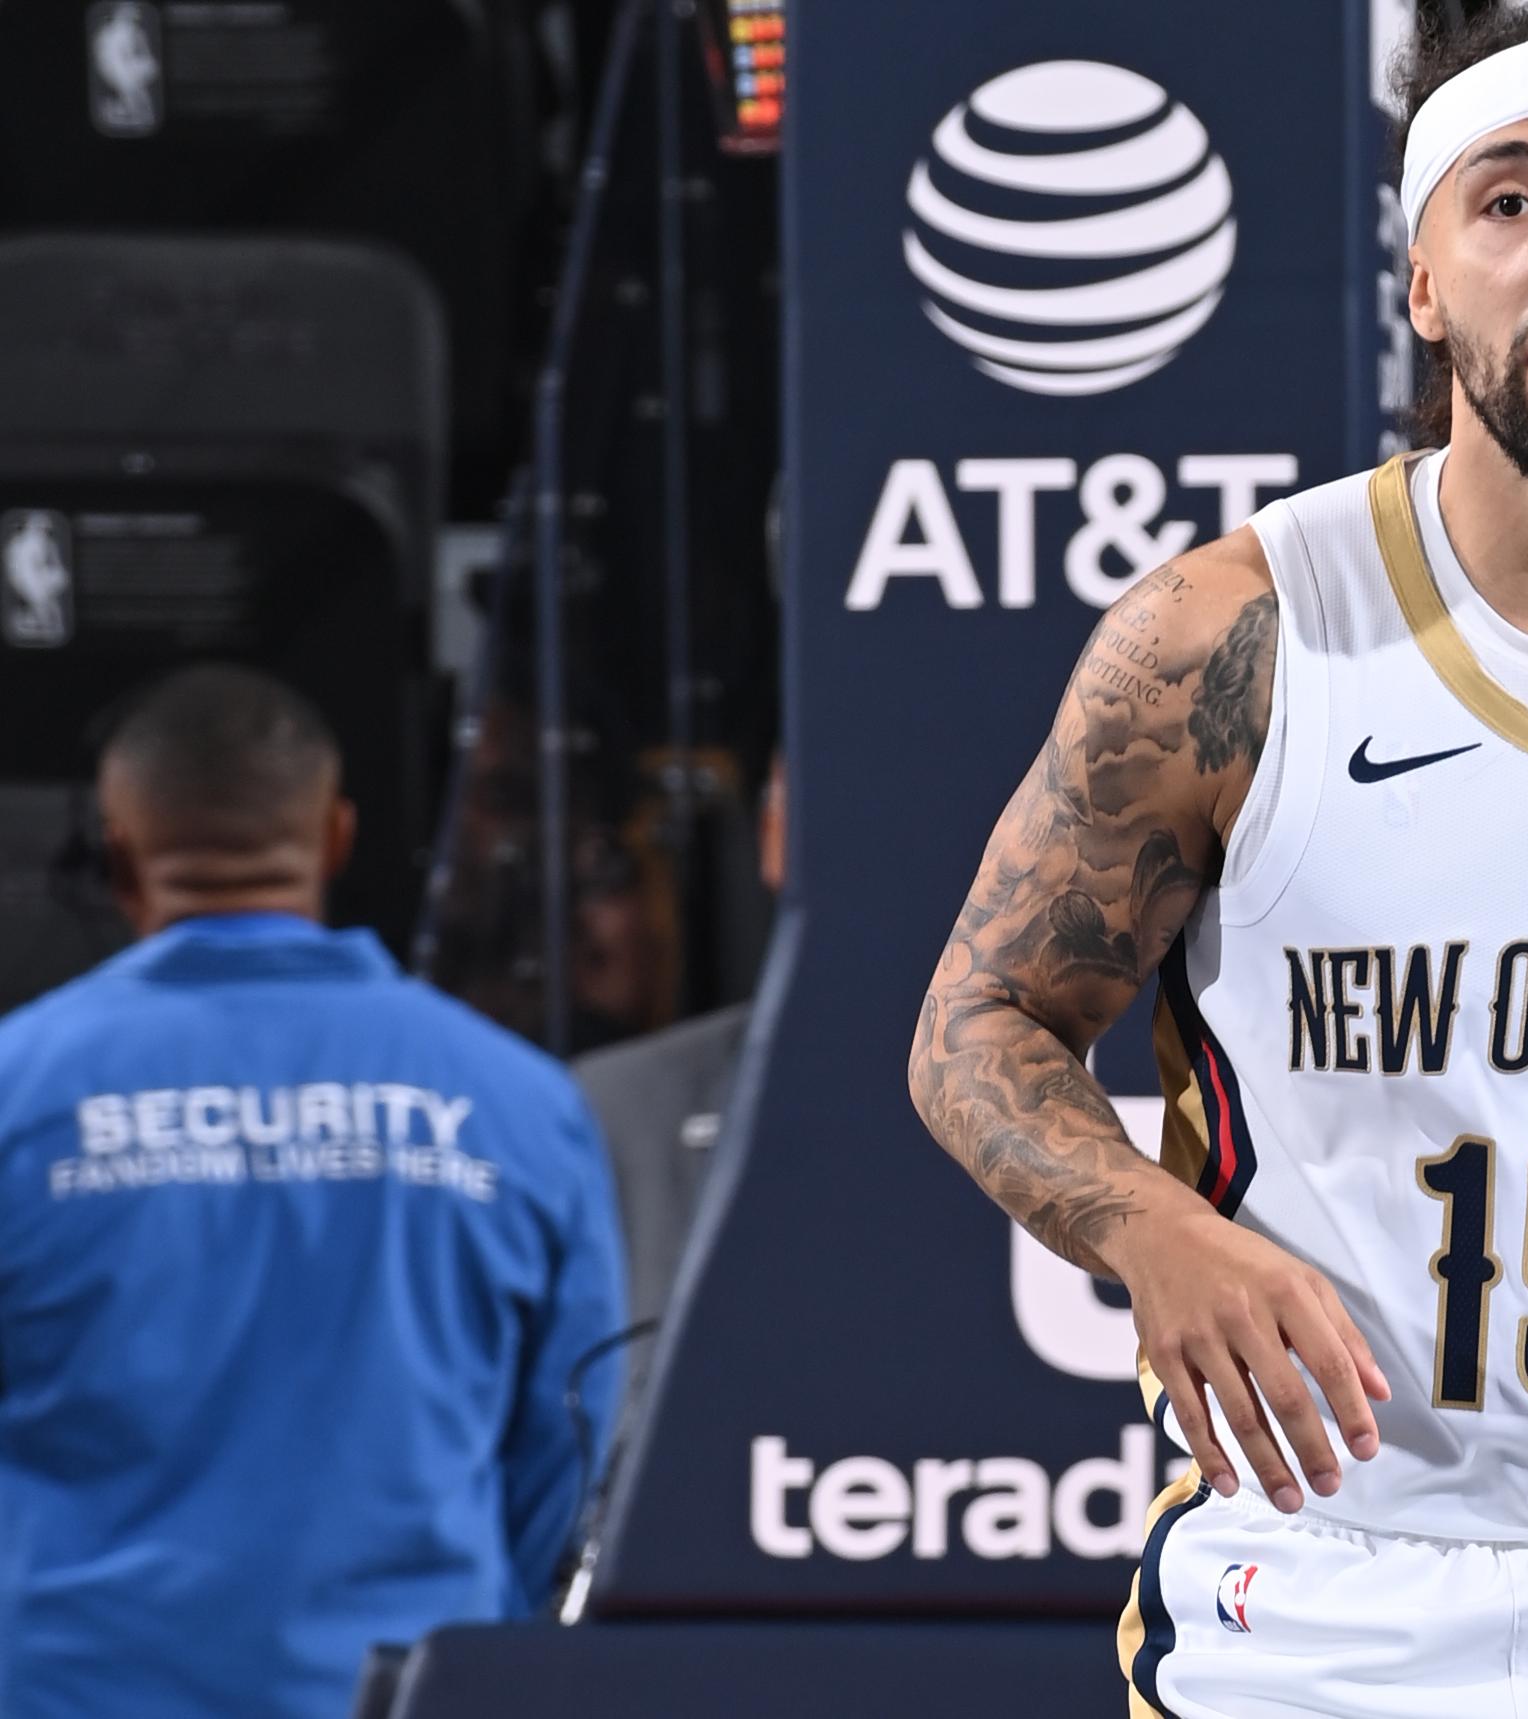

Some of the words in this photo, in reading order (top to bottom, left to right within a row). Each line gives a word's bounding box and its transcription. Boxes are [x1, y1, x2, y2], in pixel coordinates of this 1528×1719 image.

[845, 452, 1299, 611] AT&T
[1283, 939, 1469, 1077] NEW
[50, 1146, 248, 1200] FANDOM
[250, 1140, 383, 1183] LIVES
[388, 1146, 498, 1203] HERE
[77, 1082, 474, 1156] SECURITY
[750, 1424, 1195, 1560] terad
